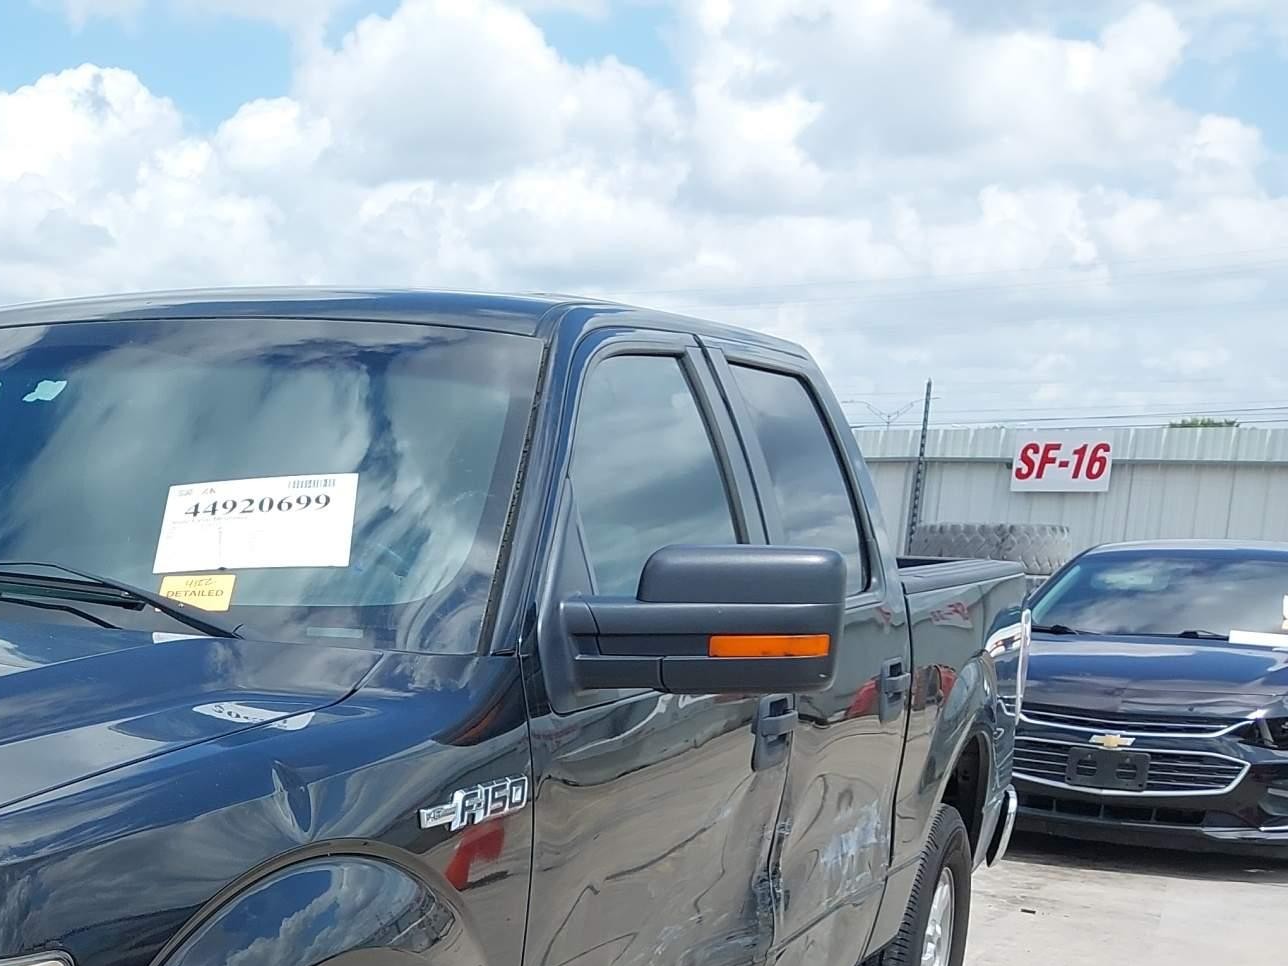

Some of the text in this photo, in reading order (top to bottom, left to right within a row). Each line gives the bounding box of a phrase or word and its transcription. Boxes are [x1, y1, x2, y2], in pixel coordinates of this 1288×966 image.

[1014, 442, 1111, 480] SF-16
[184, 493, 332, 518] 44920699
[165, 588, 225, 599] DETAILED
